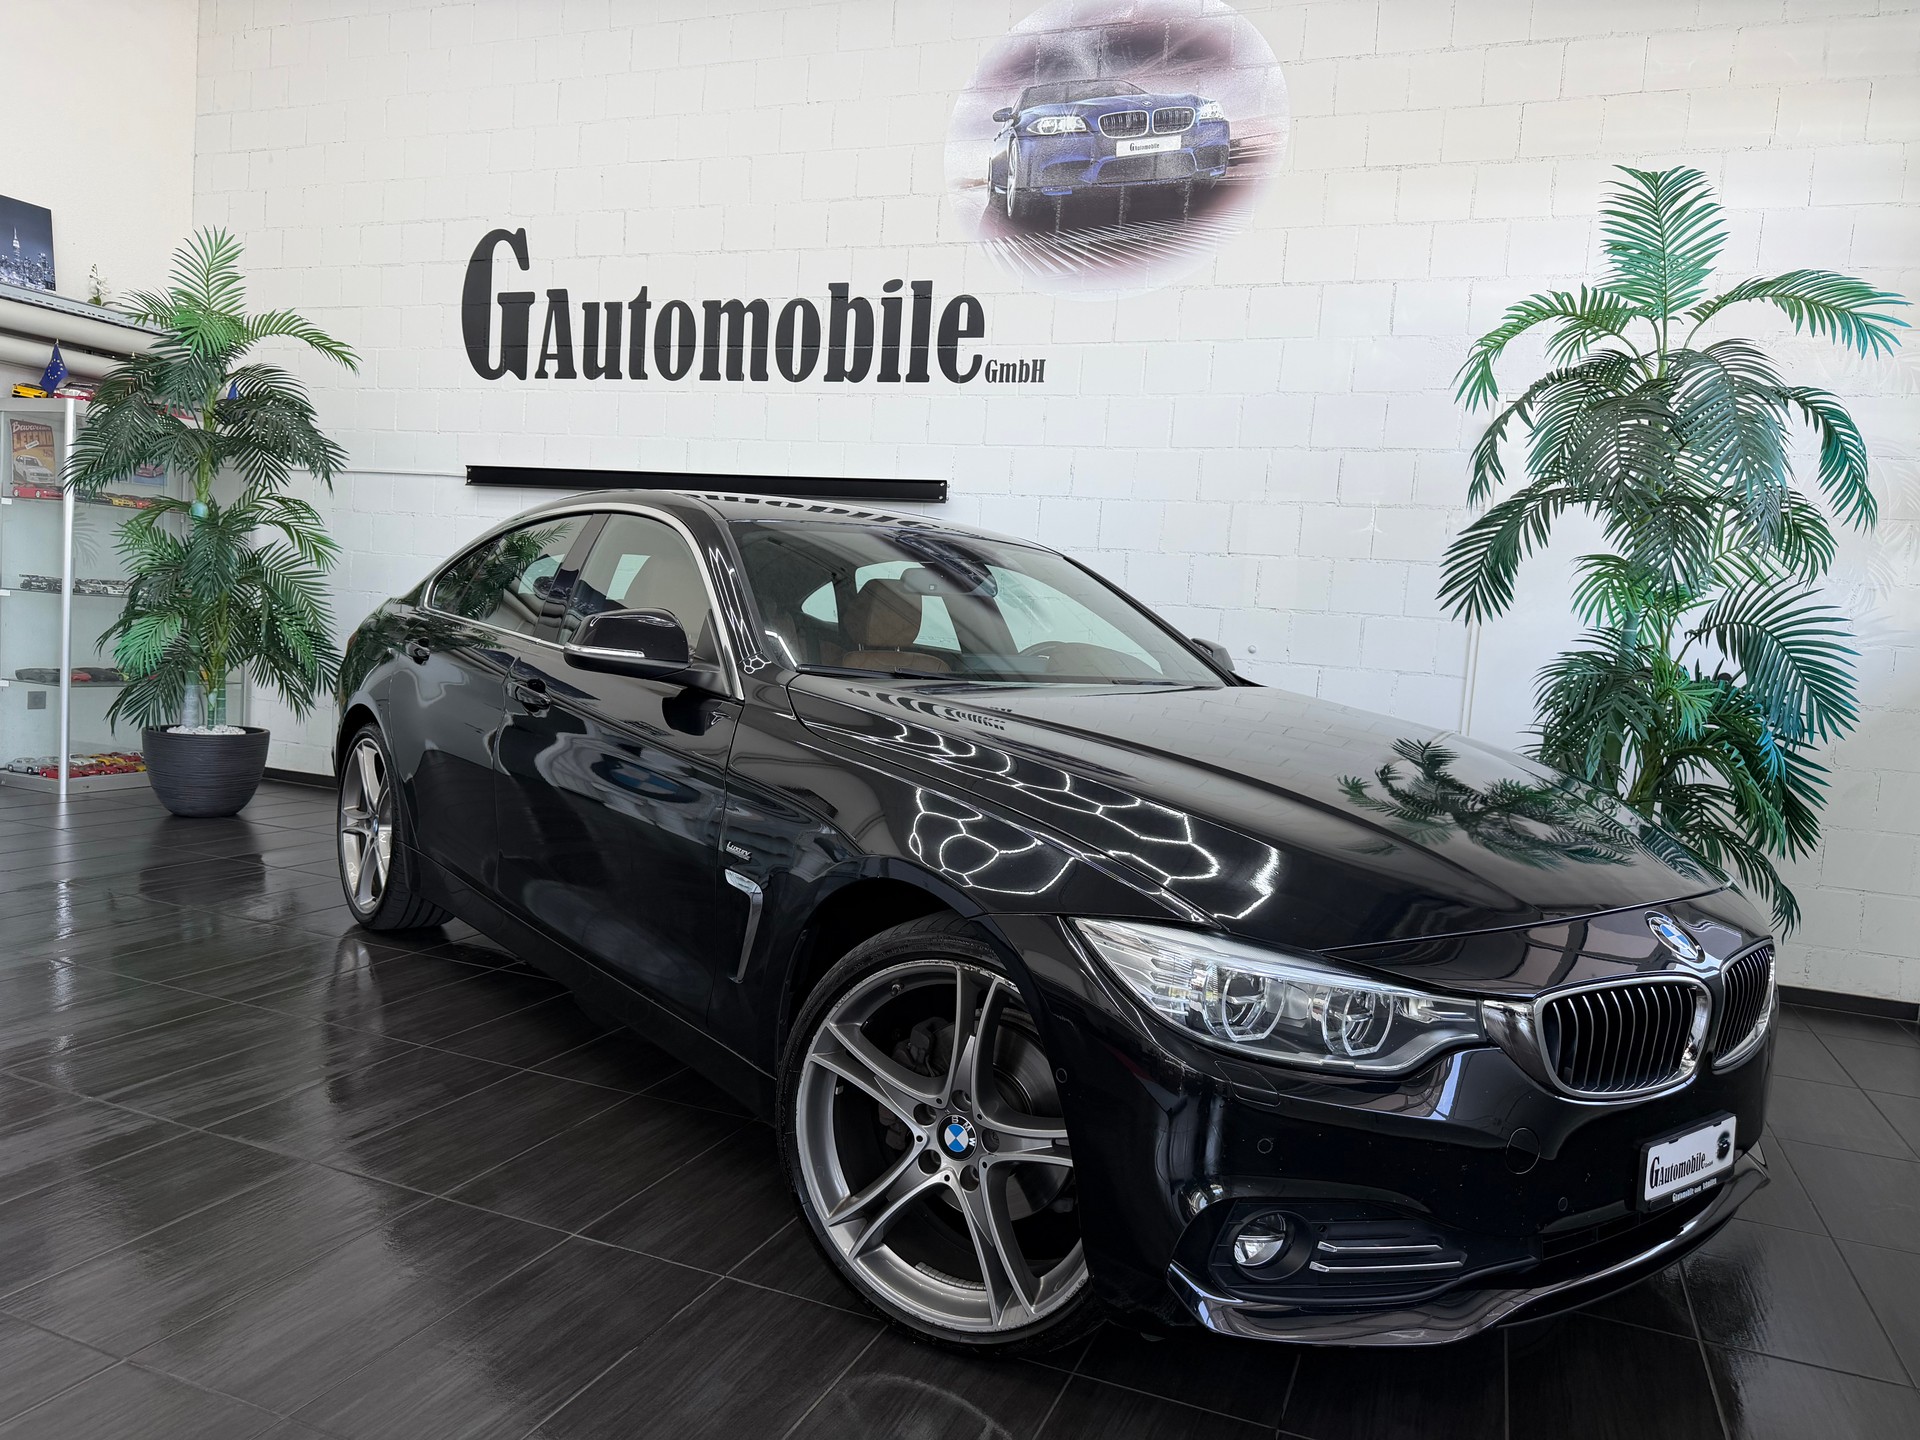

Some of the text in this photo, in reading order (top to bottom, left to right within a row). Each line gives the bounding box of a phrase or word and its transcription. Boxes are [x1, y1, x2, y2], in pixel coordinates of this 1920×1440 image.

[461, 228, 1046, 384] GAutomobile GmbH
[951, 1115, 977, 1147] BMW
[1650, 1151, 1706, 1189] GAutomobile
